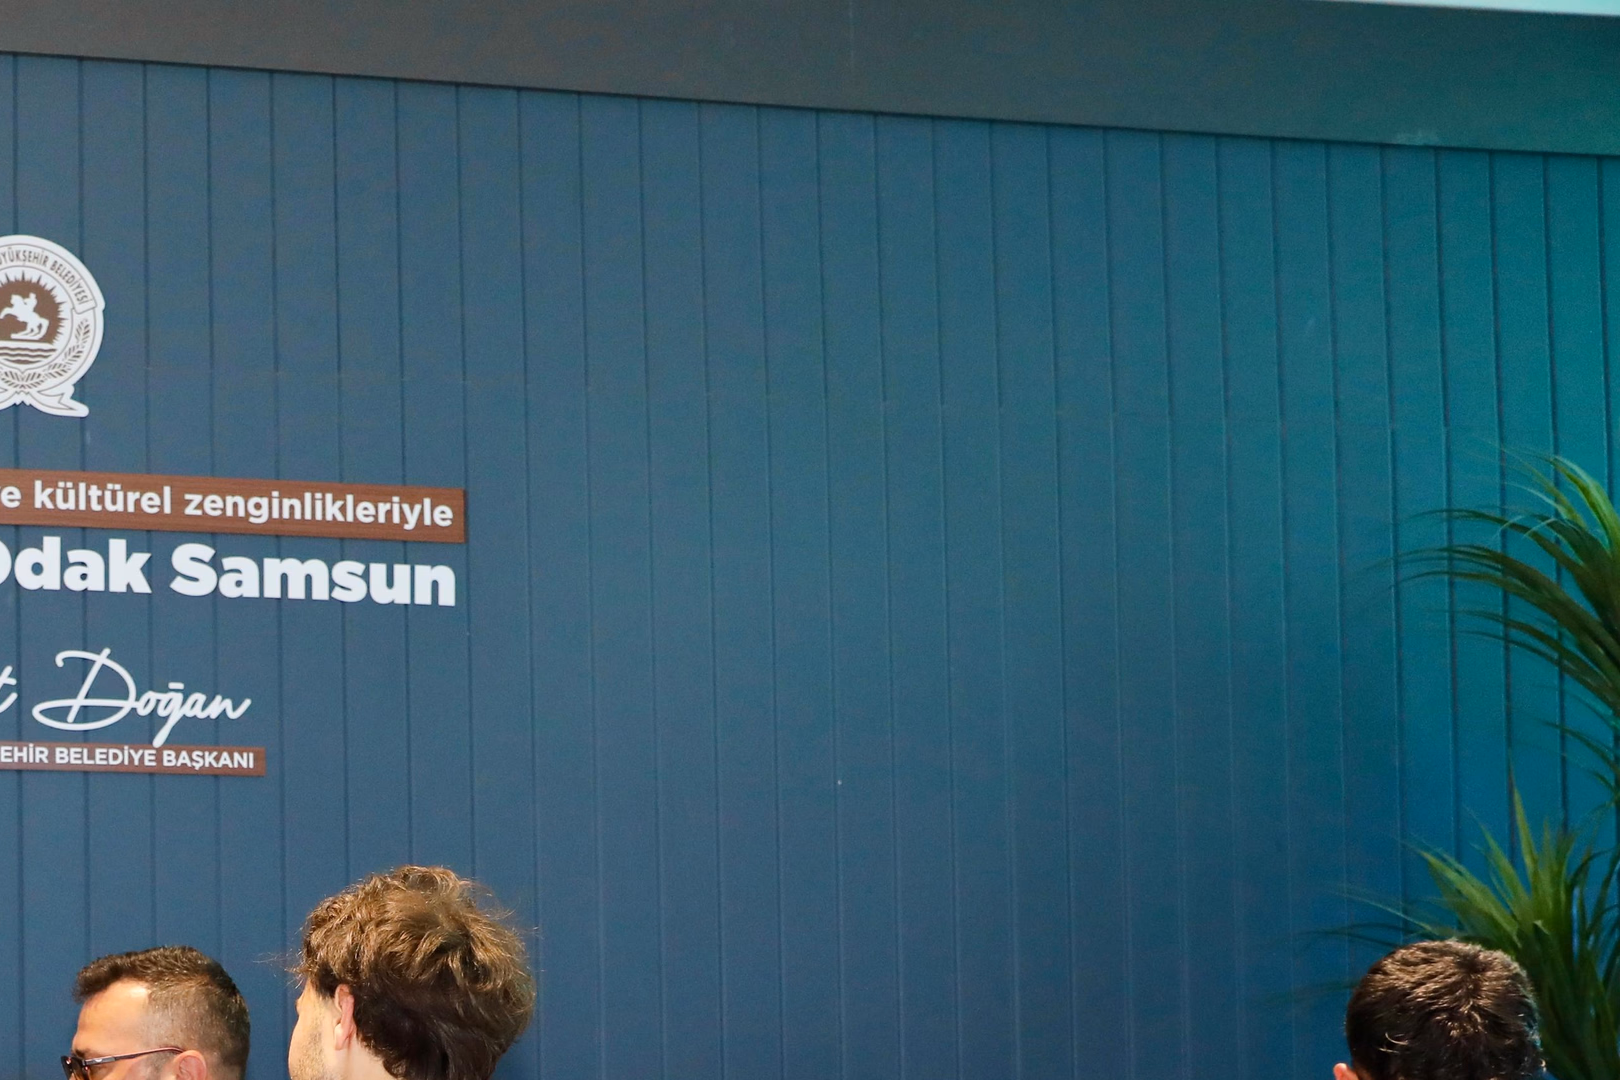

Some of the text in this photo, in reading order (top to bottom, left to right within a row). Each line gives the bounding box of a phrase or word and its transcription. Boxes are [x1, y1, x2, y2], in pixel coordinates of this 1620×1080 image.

[50, 260, 90, 305] BELEDİYESİ
[33, 479, 172, 515] kültürel
[184, 490, 454, 531] zenginlikleriyle
[169, 542, 457, 607] Samsun
[31, 647, 252, 748] Doğan
[55, 747, 157, 768] BELEDİYE
[163, 750, 255, 771] BAŞKANI
